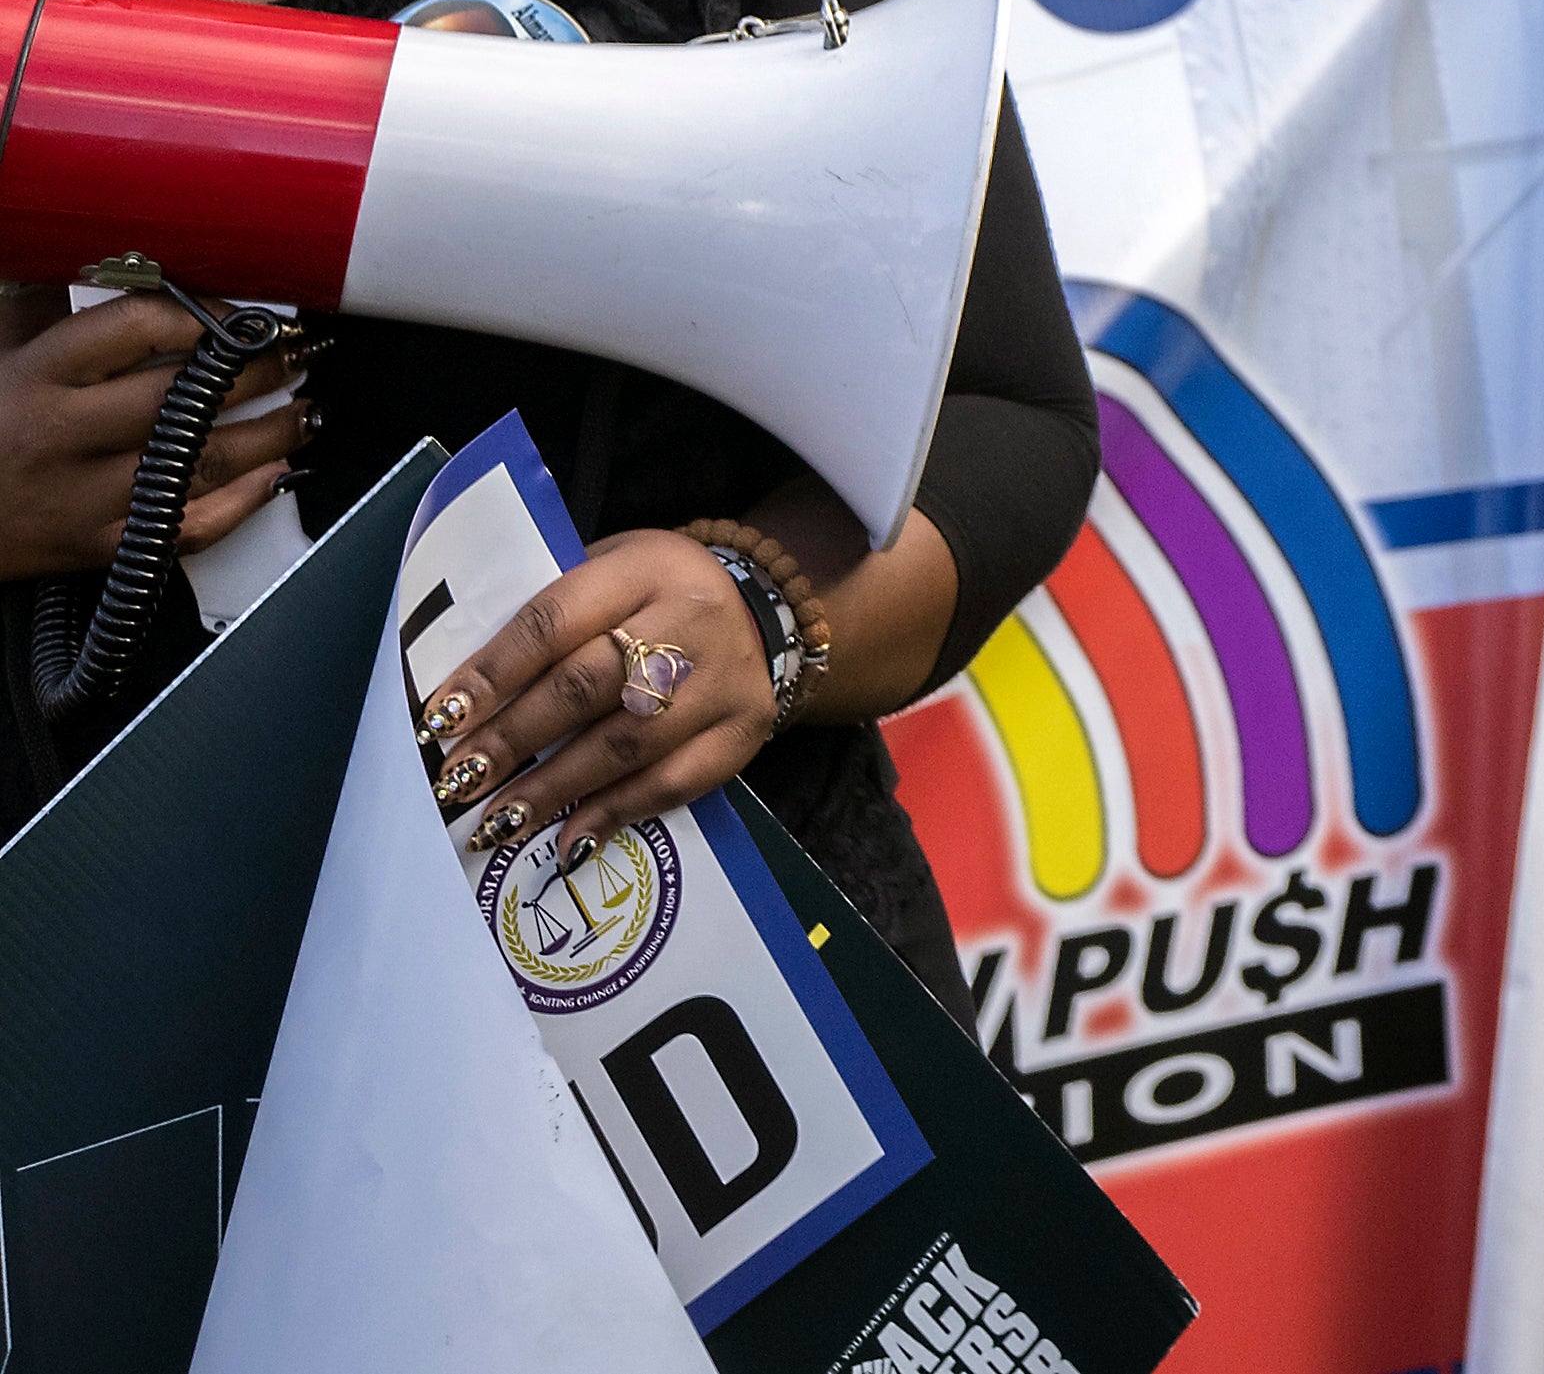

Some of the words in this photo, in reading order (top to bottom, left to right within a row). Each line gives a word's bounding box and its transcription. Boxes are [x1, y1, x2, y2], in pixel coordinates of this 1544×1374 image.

[529, 992, 575, 1009] IGNITING
[576, 983, 618, 1005] CHANGE
[619, 978, 629, 988] &
[625, 930, 665, 981] INSPIRING
[661, 886, 677, 932] ACTION
[841, 1337, 864, 1360] YOU
[861, 1293, 899, 1339] MATTER
[897, 1275, 914, 1294] WE
[912, 1232, 951, 1277] MATTER
[877, 1242, 1000, 1374] ACK
